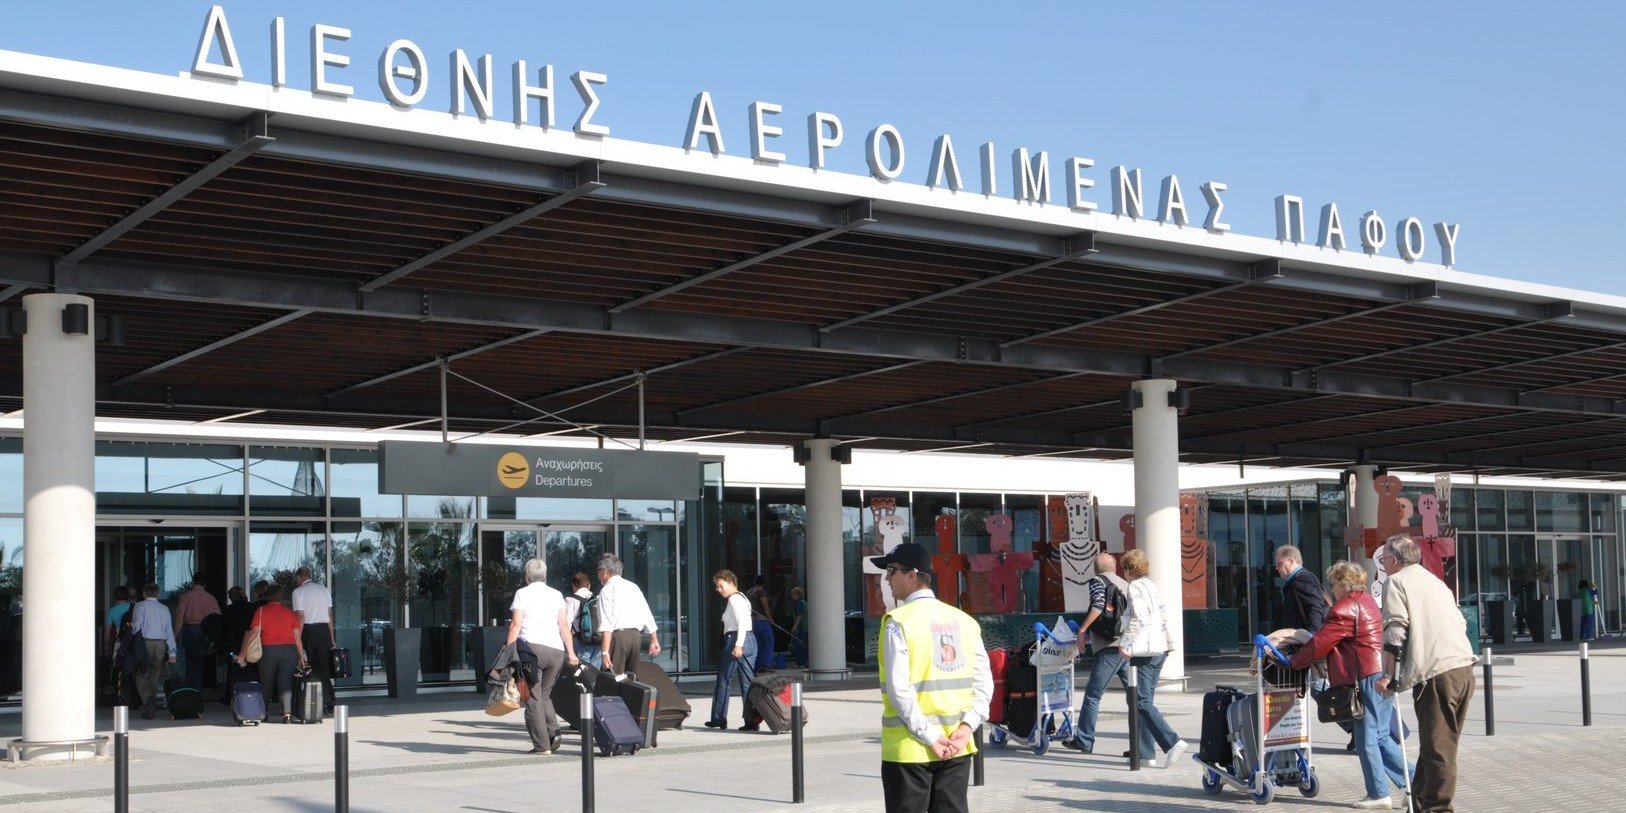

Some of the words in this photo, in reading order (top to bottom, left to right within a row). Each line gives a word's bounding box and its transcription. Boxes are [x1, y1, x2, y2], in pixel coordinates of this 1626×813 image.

[193, 5, 610, 136] ΔΙΕΘΝΗΣ
[683, 90, 1231, 233] ΑΕΡΟΛΙΜΕΝΑΣ
[1275, 194, 1460, 267] ΠΑΦΟΥ
[535, 456, 603, 473] Αναχωρήσεις
[535, 474, 593, 487] Departures
